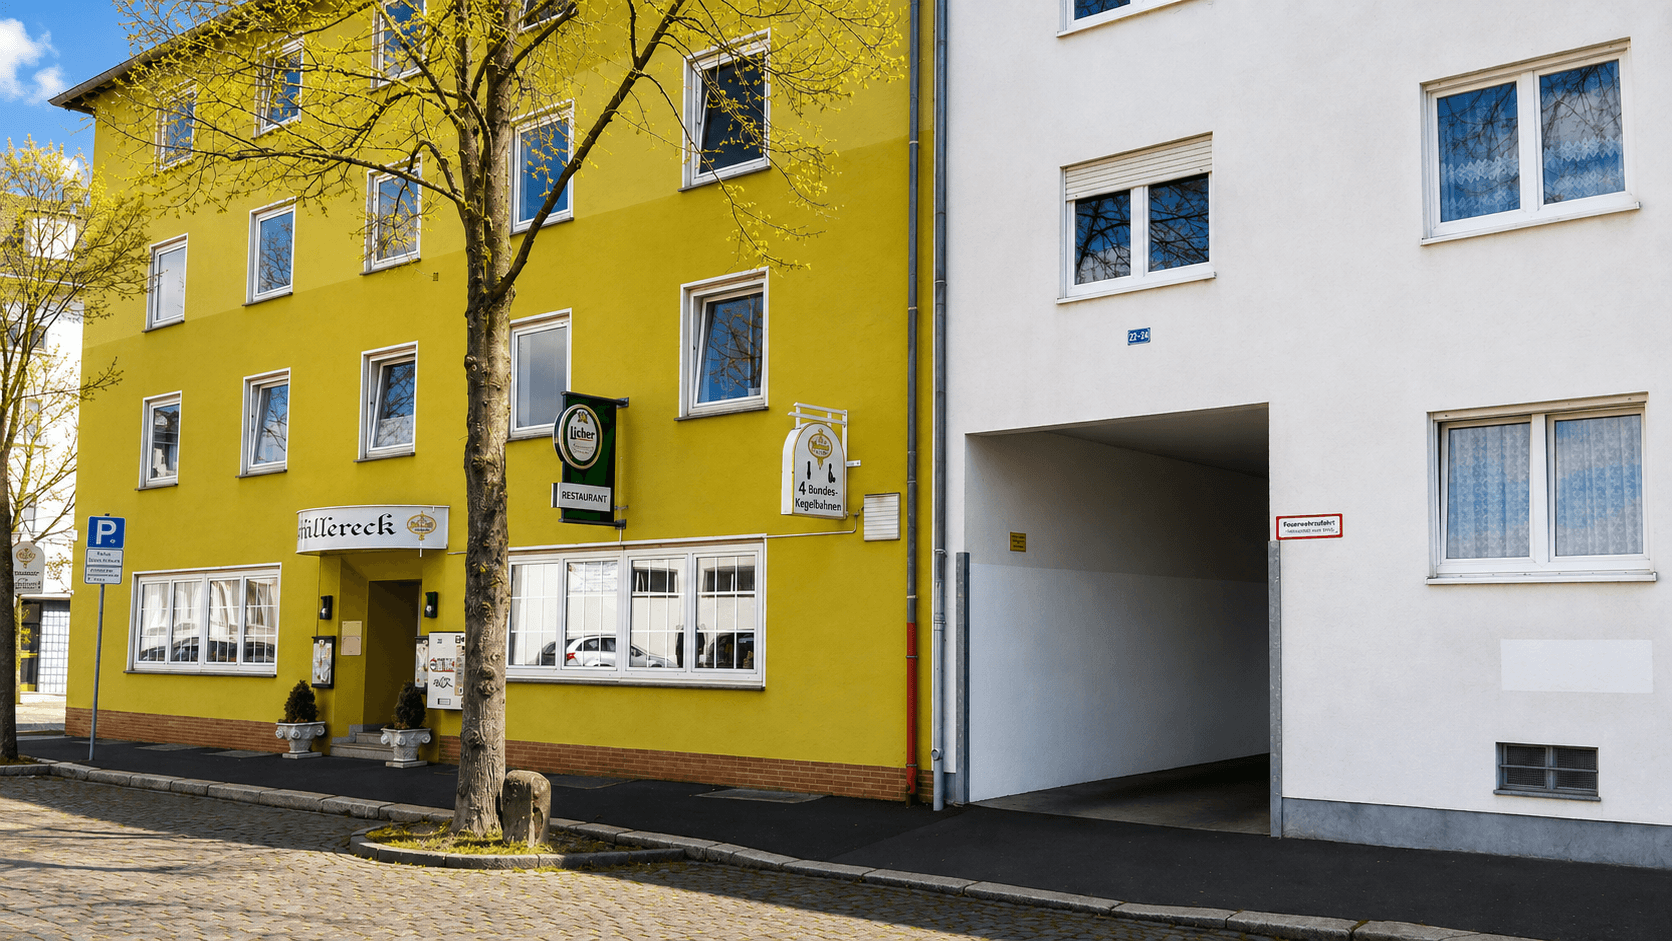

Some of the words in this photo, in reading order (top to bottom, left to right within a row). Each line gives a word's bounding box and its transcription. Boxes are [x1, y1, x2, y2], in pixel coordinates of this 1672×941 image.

[570, 425, 596, 440] Licher
[798, 481, 807, 496] 4
[561, 490, 608, 504] RESTAURANT
[795, 497, 842, 512] Kegelbahnen
[95, 519, 117, 545] P
